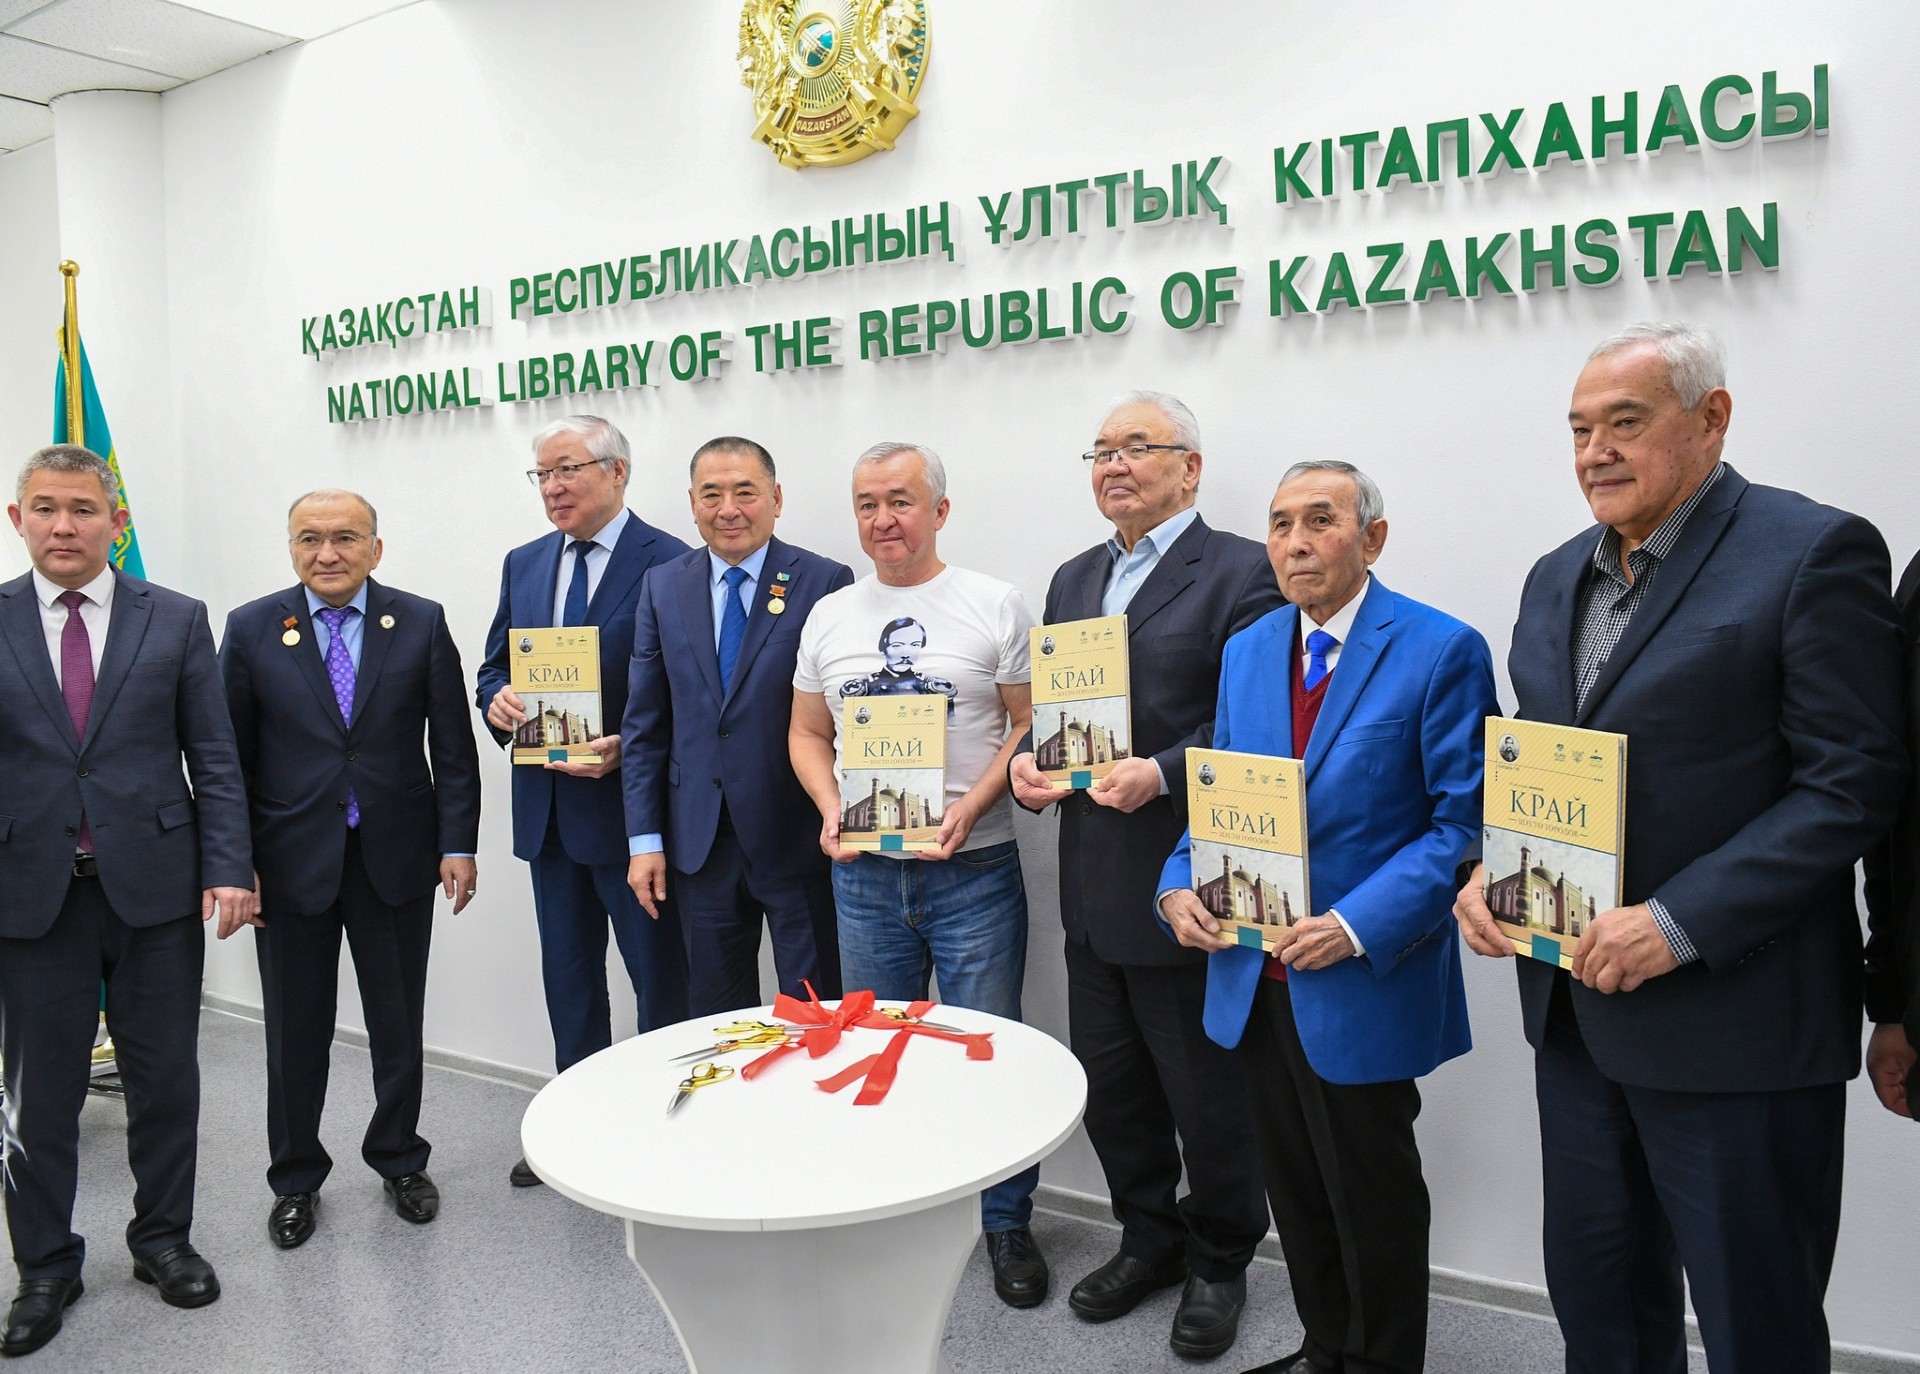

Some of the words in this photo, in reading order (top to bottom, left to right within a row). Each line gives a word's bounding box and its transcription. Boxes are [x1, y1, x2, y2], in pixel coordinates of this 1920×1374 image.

[796, 108, 850, 132] QAZAQSTAN
[302, 287, 479, 358] ҚАЗАҚСТАН
[510, 201, 954, 320] РЕСПУБЛИКАСЫНЫҢ
[980, 157, 1227, 244] ҰЛТТЫҚ
[1274, 64, 1829, 203] КІТАПХАНАСЫ
[327, 367, 481, 422] NATIONAL
[498, 340, 654, 403] LIBRARY
[669, 331, 722, 381] OF
[745, 317, 832, 372] THE
[859, 277, 1127, 360] REPUBLIC
[1160, 266, 1237, 329] OF
[1269, 202, 1779, 317] KAZAKHSTAN
[528, 664, 579, 682] КРАЙ
[1050, 664, 1105, 690] КРАЙ
[863, 737, 923, 757] КРАЙ
[1510, 789, 1587, 828] КРАЙ
[1210, 808, 1276, 837] КРАЙ
